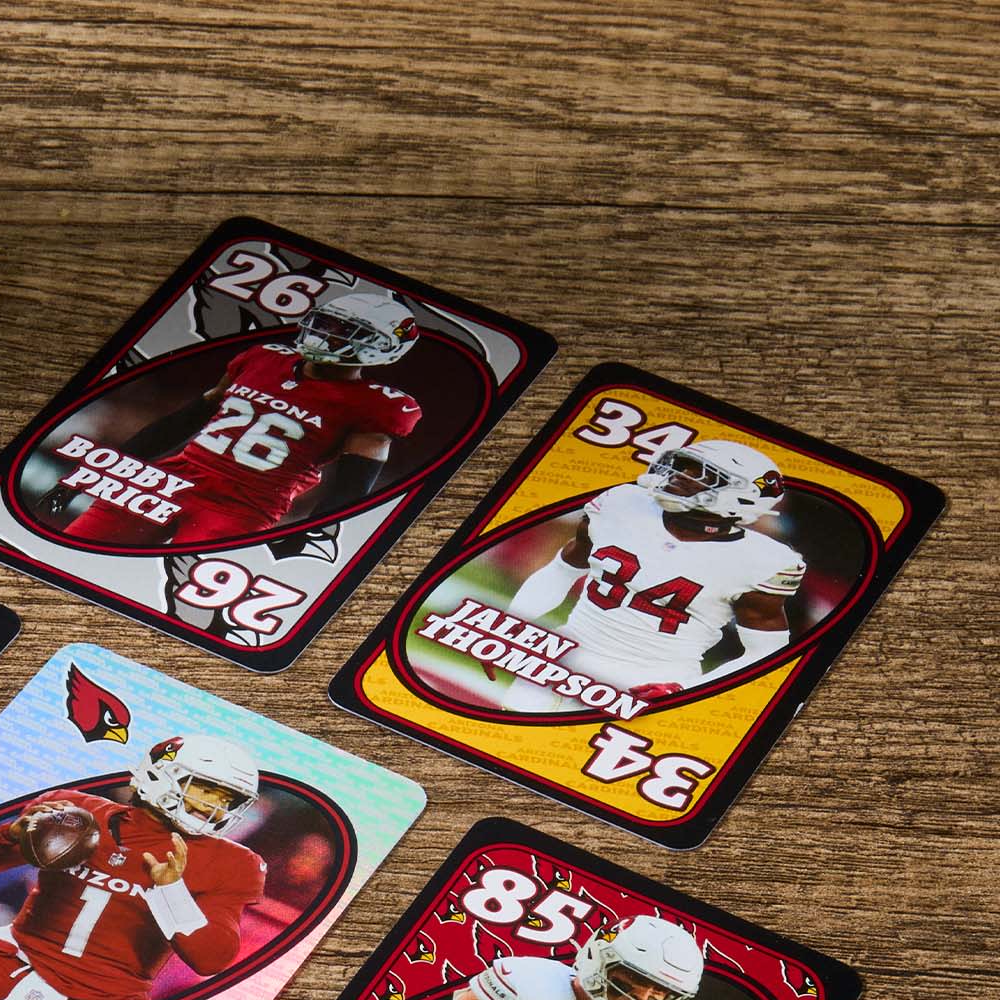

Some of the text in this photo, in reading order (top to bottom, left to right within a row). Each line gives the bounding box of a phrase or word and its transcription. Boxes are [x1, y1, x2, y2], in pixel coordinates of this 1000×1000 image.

[207, 251, 327, 316] 26
[194, 396, 305, 472] 26
[226, 383, 322, 429] ARIZONA
[574, 398, 697, 465] 34
[55, 434, 196, 499] BOBBY
[61, 465, 183, 525] PRICE
[177, 559, 305, 635] 26
[586, 544, 705, 636] 34
[445, 599, 577, 660] JALEN
[417, 613, 650, 721] THOMPSON
[427, 721, 524, 743] CARDINALS
[656, 719, 741, 739] CARDINAL
[584, 724, 714, 811] 34
[61, 884, 113, 959] 1
[460, 866, 595, 946] 85
